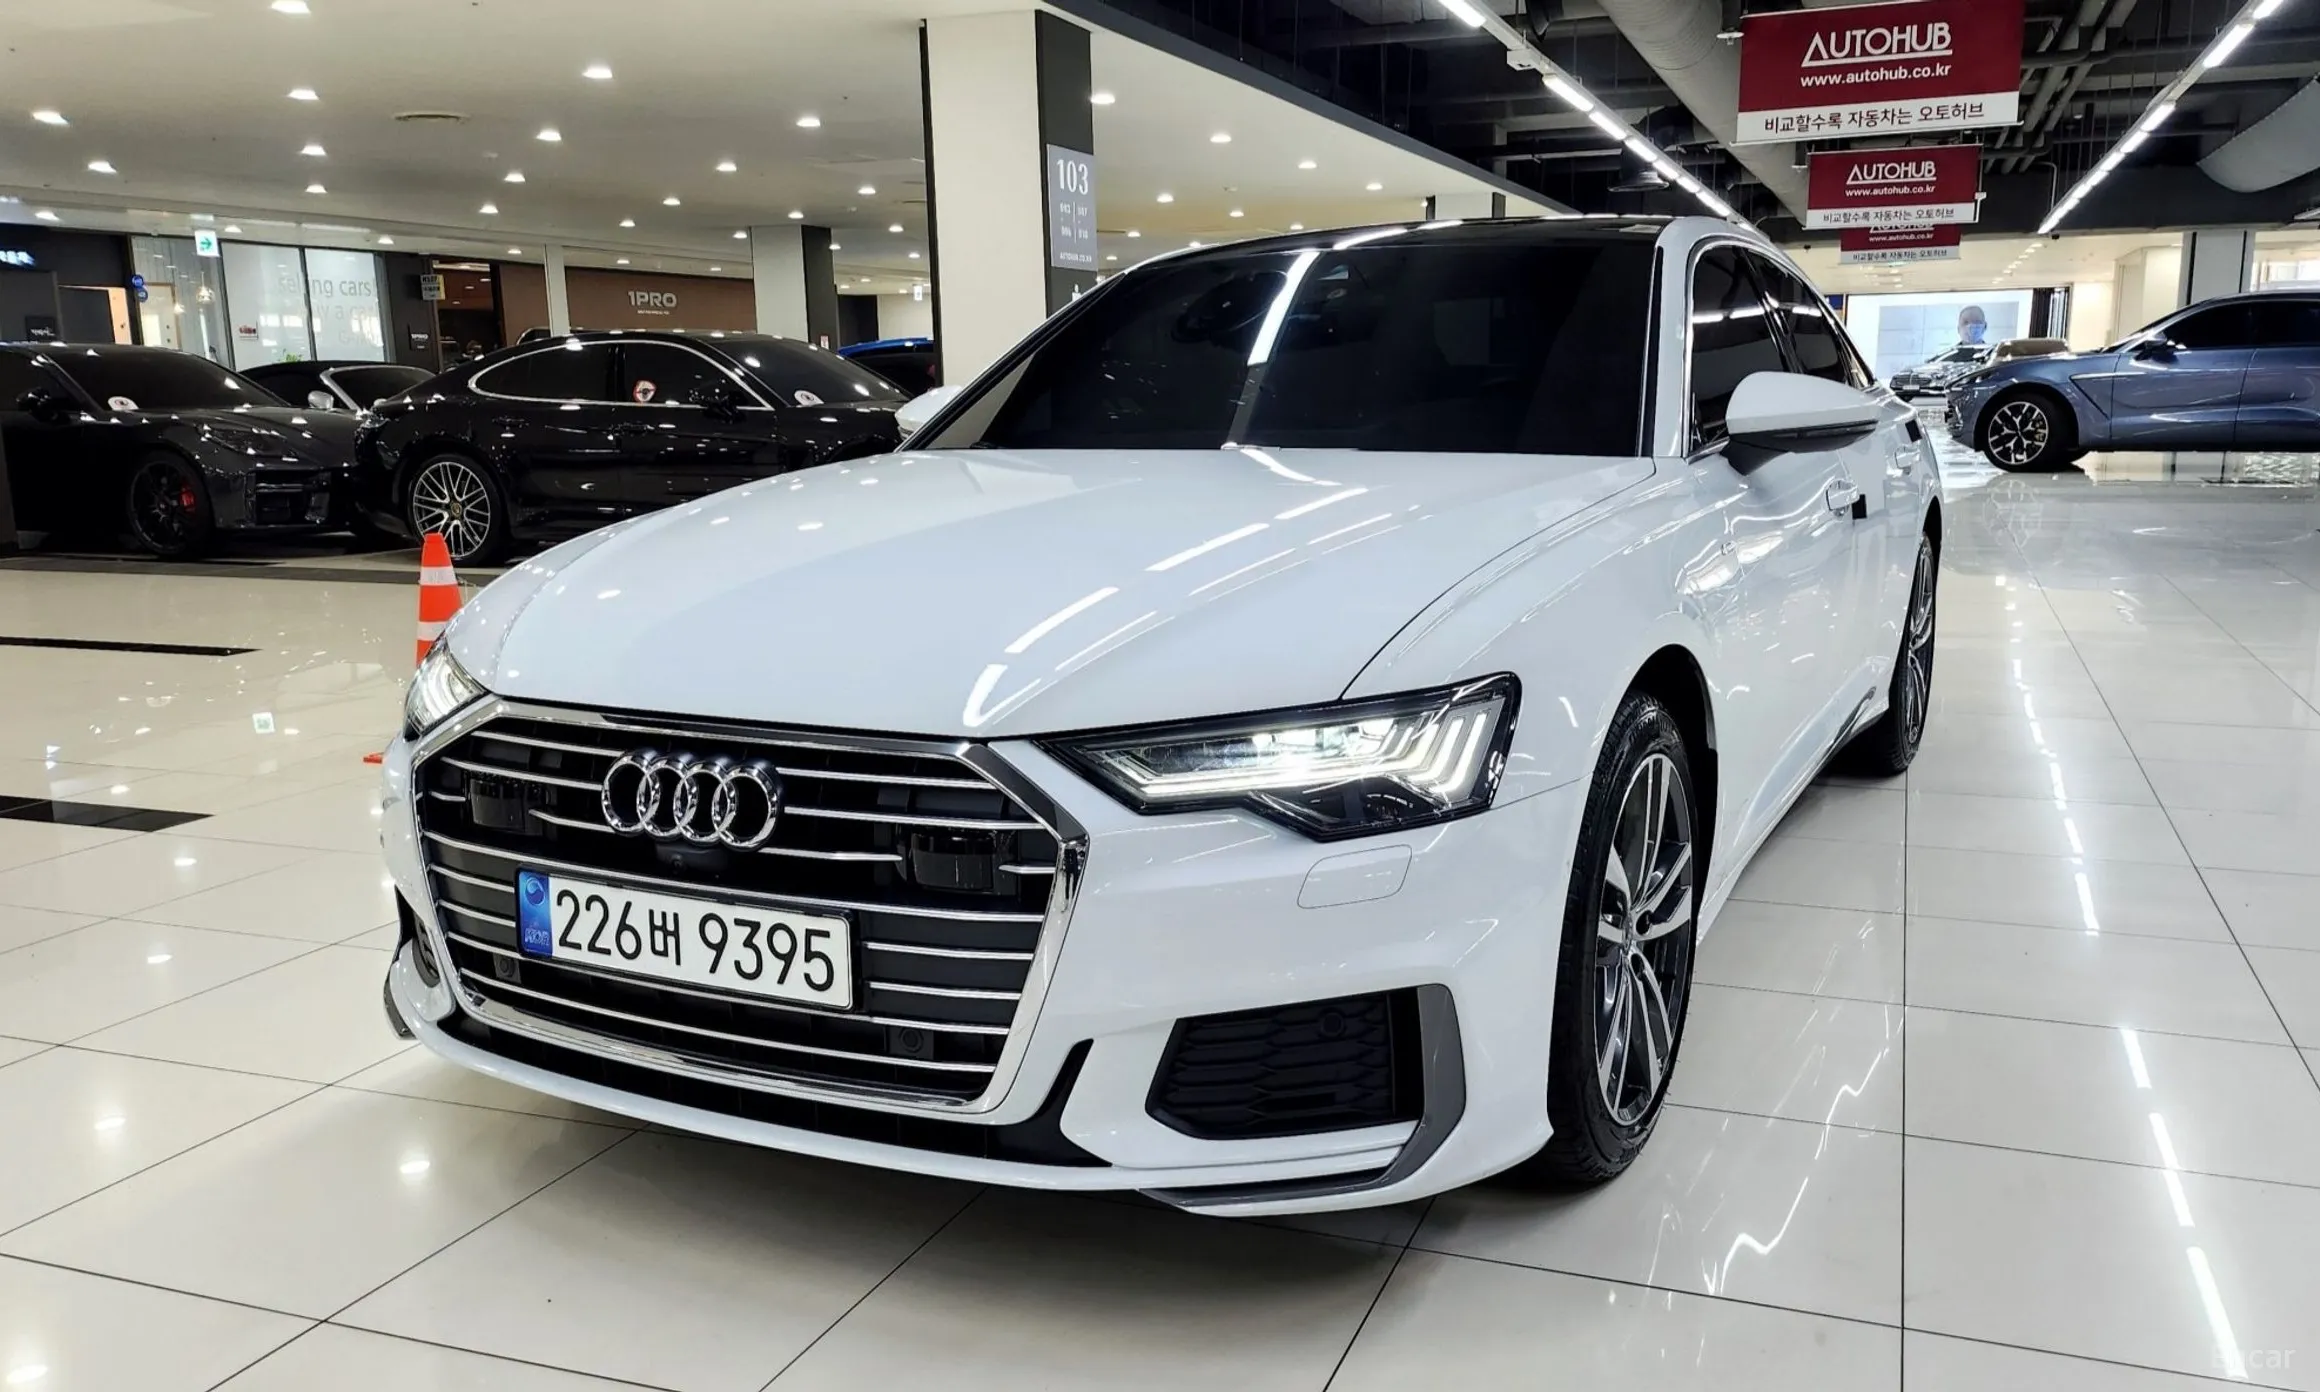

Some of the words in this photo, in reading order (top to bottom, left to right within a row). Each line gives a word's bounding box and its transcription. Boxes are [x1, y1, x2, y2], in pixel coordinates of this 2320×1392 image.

[1801, 22, 1952, 67] AUTOHUB
[1801, 63, 1952, 87] www.autohub.co.kr
[1764, 112, 1843, 135] 비교할수록
[1848, 106, 1912, 128] 자동차는
[1919, 102, 1985, 121] 오토허브
[1057, 159, 1088, 195] 103
[1846, 160, 1937, 185] AUTOHUB
[1845, 185, 1936, 197] www.autohub.co.kr
[340, 280, 372, 297] cars
[628, 291, 677, 307] 1PRO
[556, 889, 681, 966] 226버
[699, 912, 834, 992] 9395
